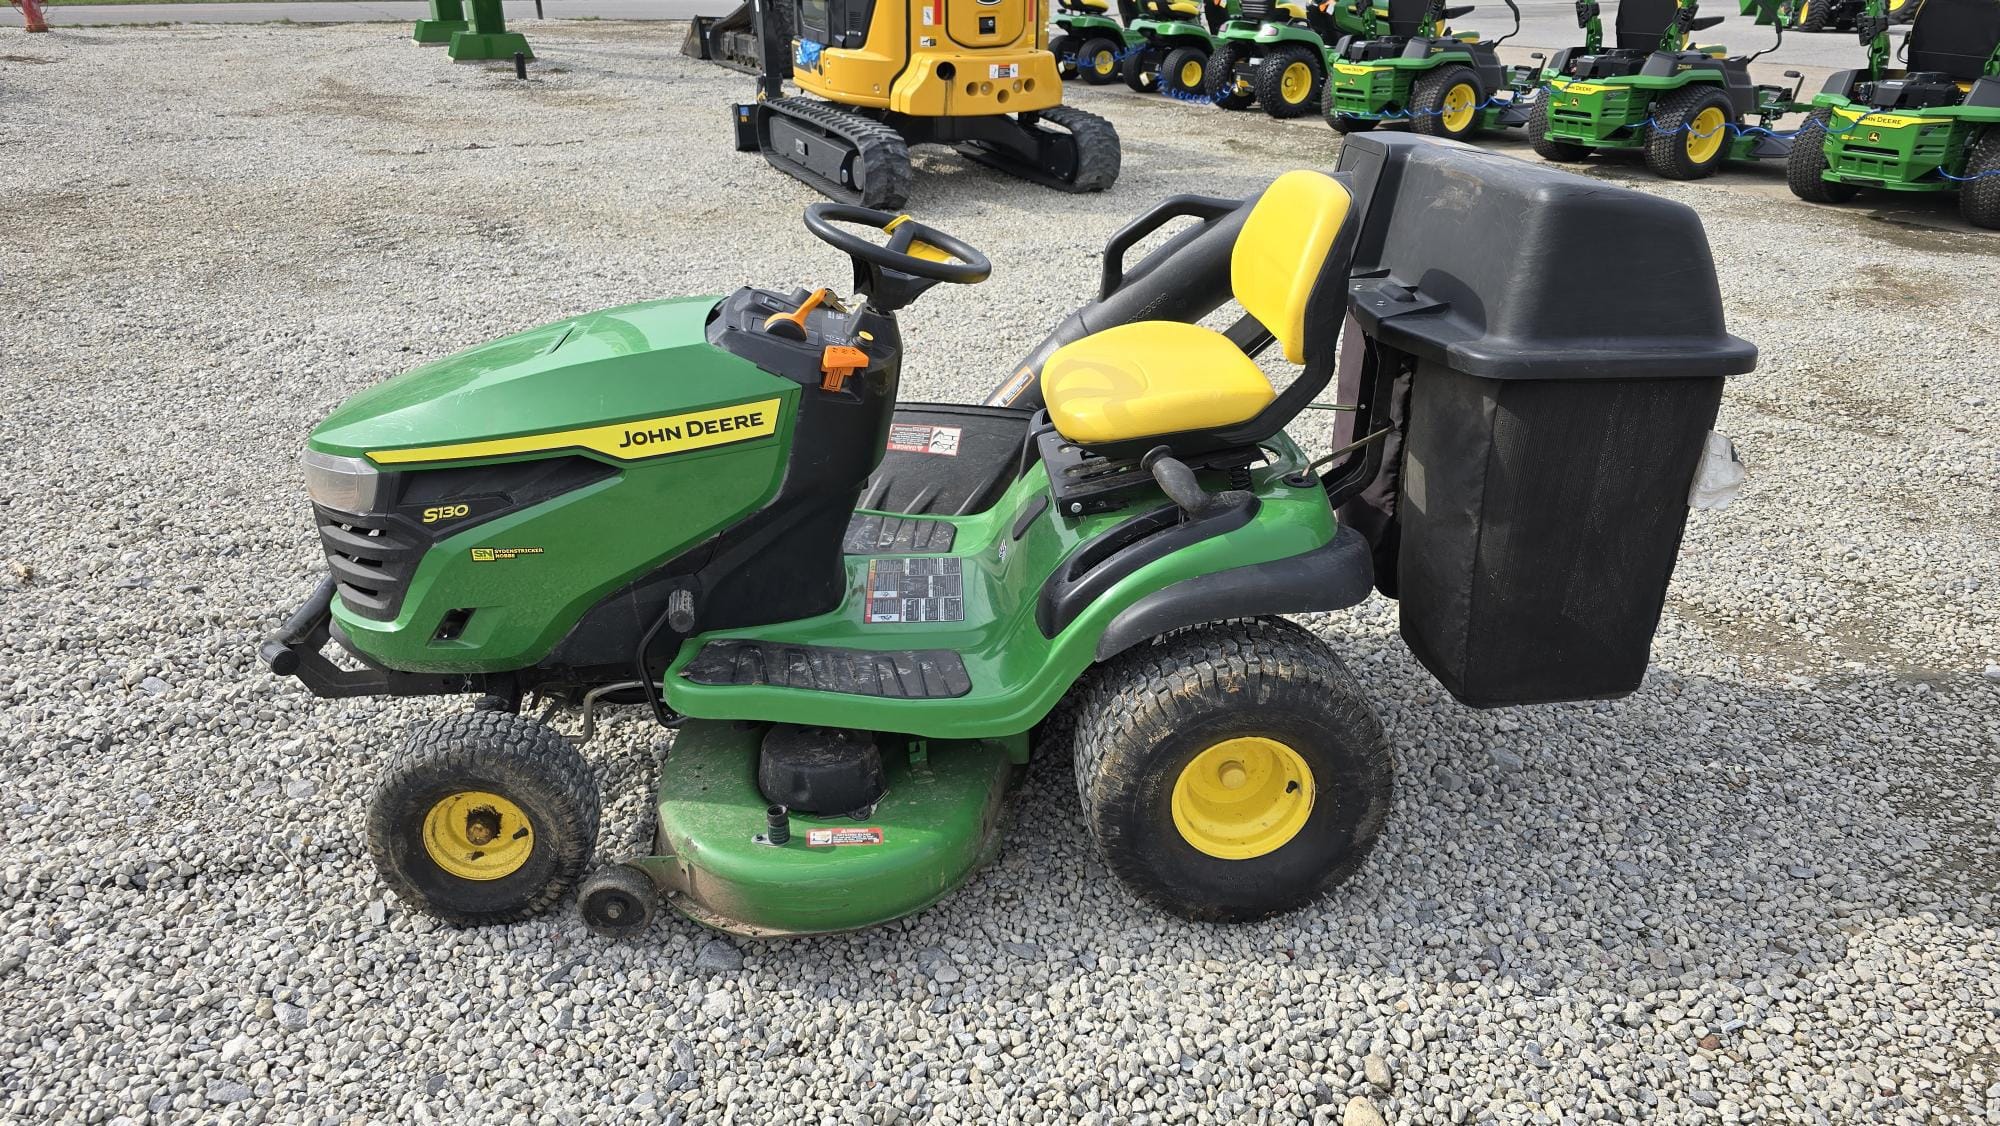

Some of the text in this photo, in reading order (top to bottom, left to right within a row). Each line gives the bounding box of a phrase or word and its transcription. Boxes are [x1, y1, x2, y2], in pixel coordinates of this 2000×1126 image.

[1876, 116, 1902, 125] DEERE
[619, 412, 764, 448] JOHN DEERE
[422, 504, 470, 523] S130
[474, 549, 494, 558] SN
